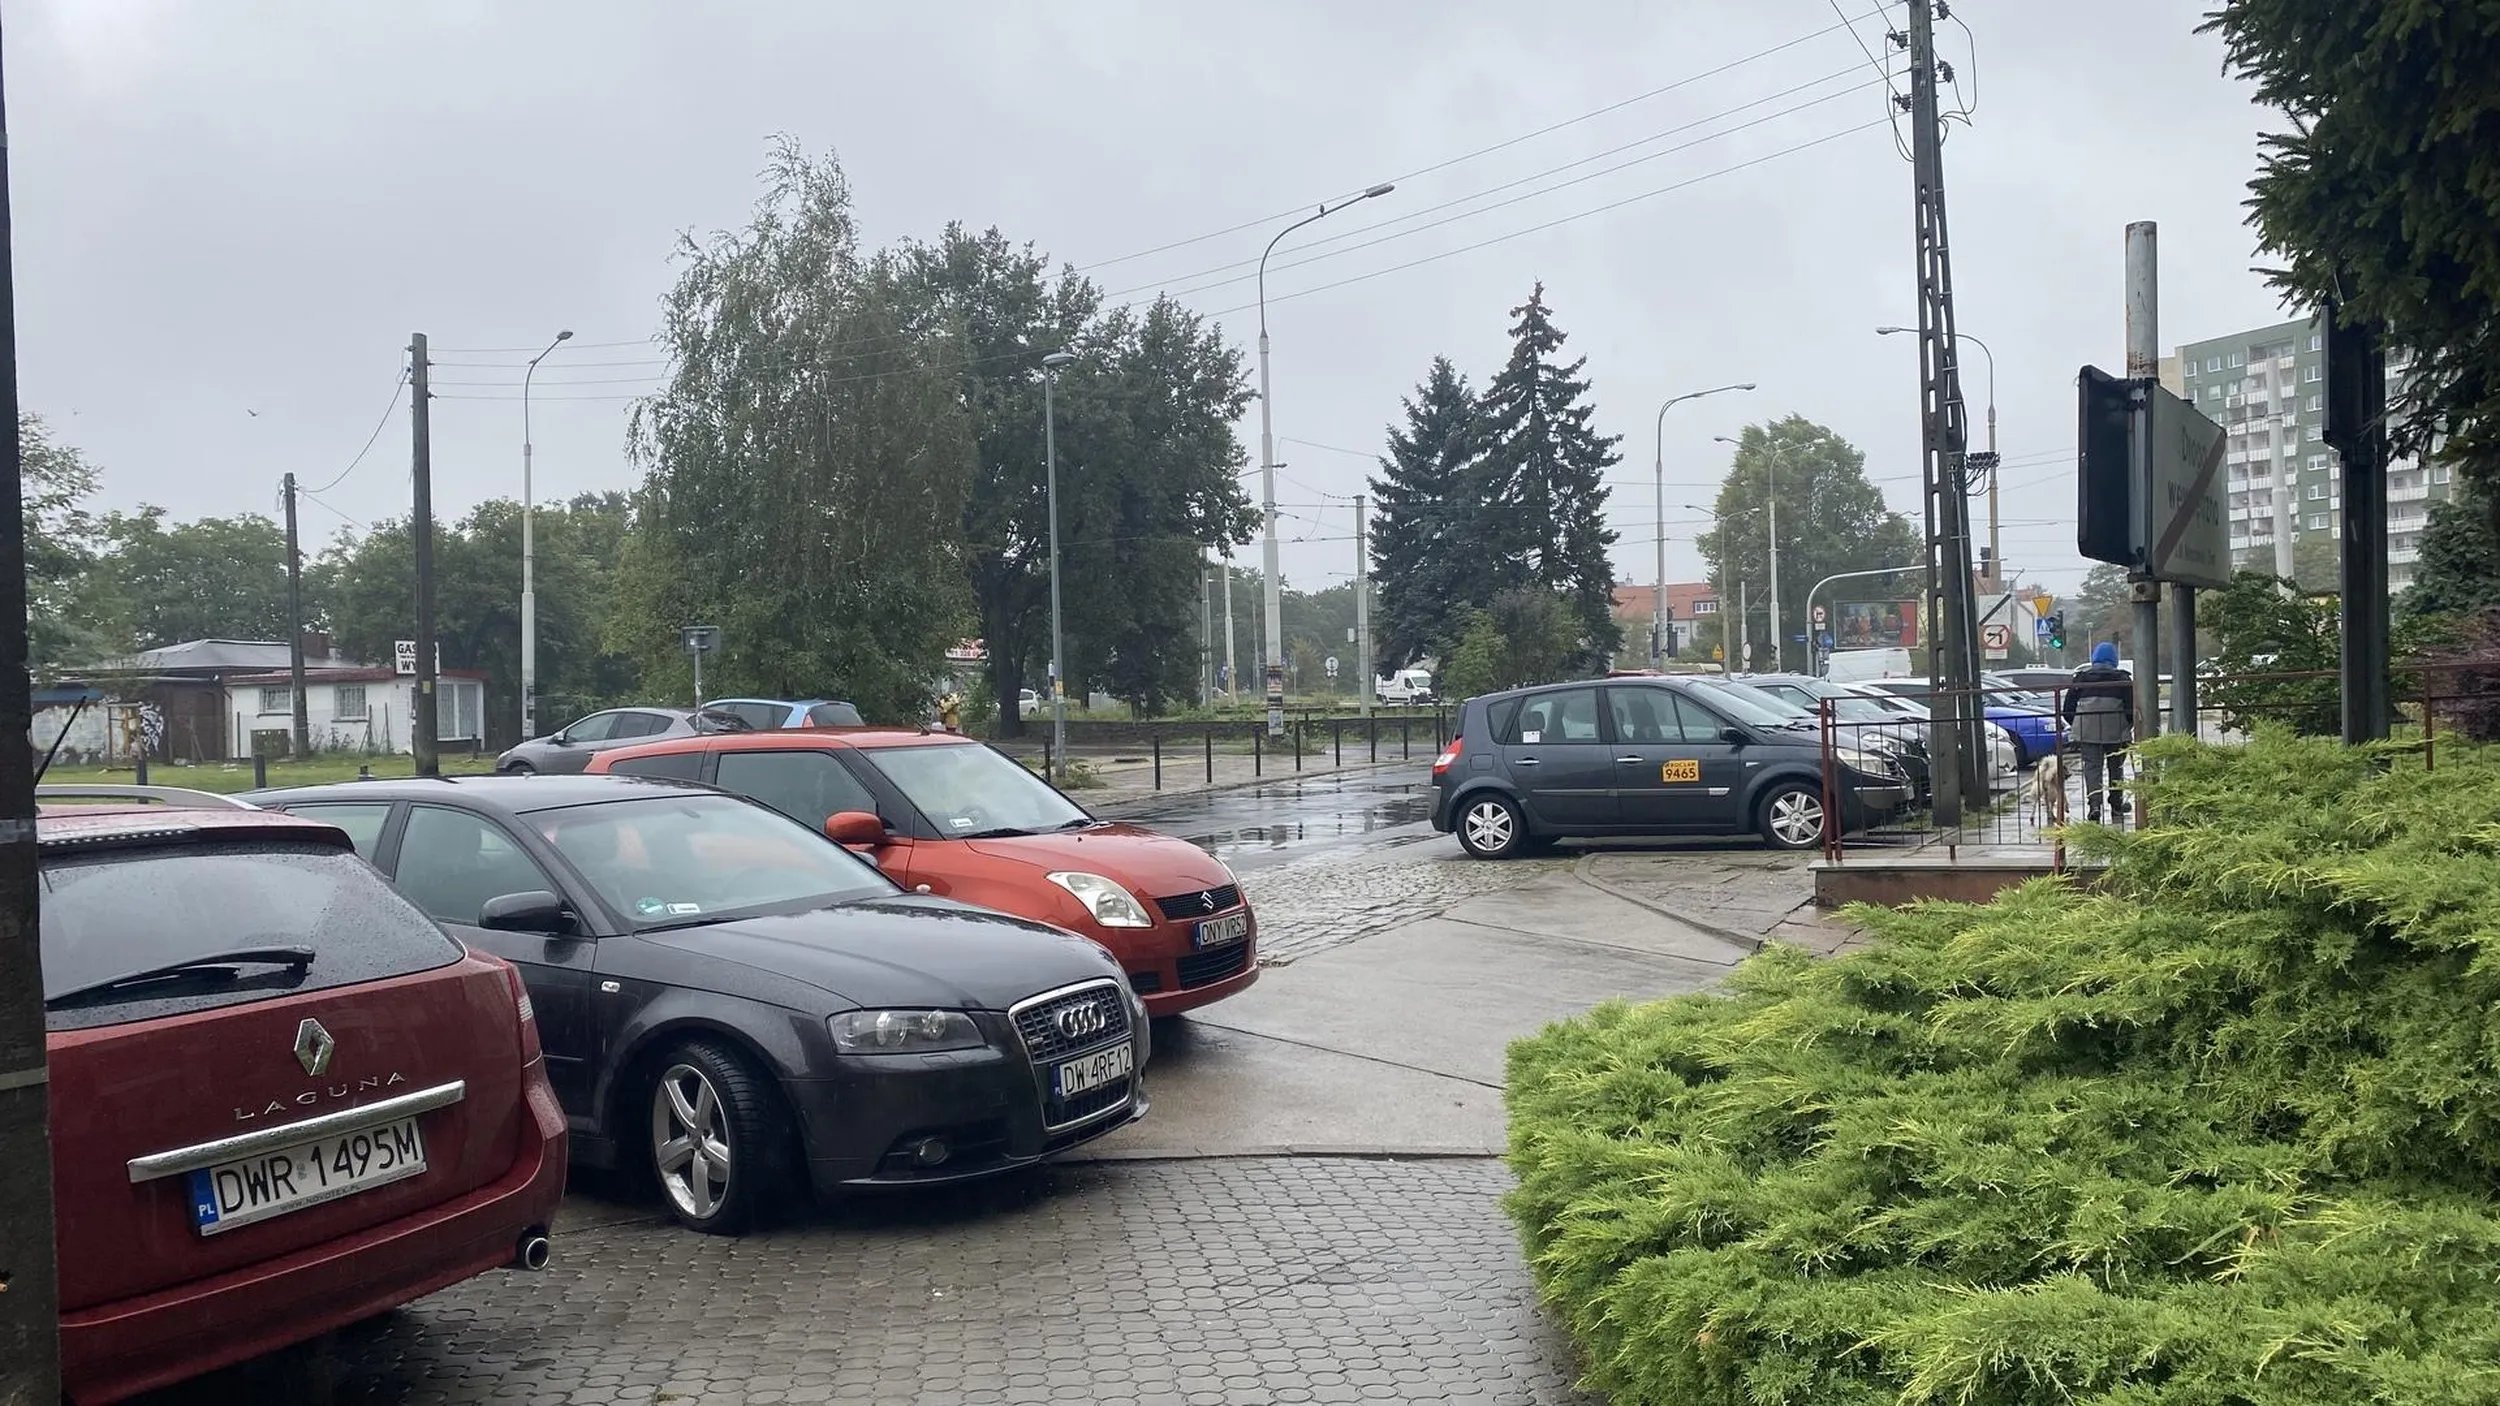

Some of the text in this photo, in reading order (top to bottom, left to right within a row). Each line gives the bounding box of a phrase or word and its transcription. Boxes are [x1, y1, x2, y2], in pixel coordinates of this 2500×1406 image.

[1665, 767, 1696, 779] 9465
[1202, 921, 1222, 942] ONY
[1064, 1046, 1131, 1094] DW 4RF12
[234, 1071, 406, 1121] LAGUNA
[215, 1122, 419, 1214] DWR 1495M
[199, 1204, 215, 1216] PL
